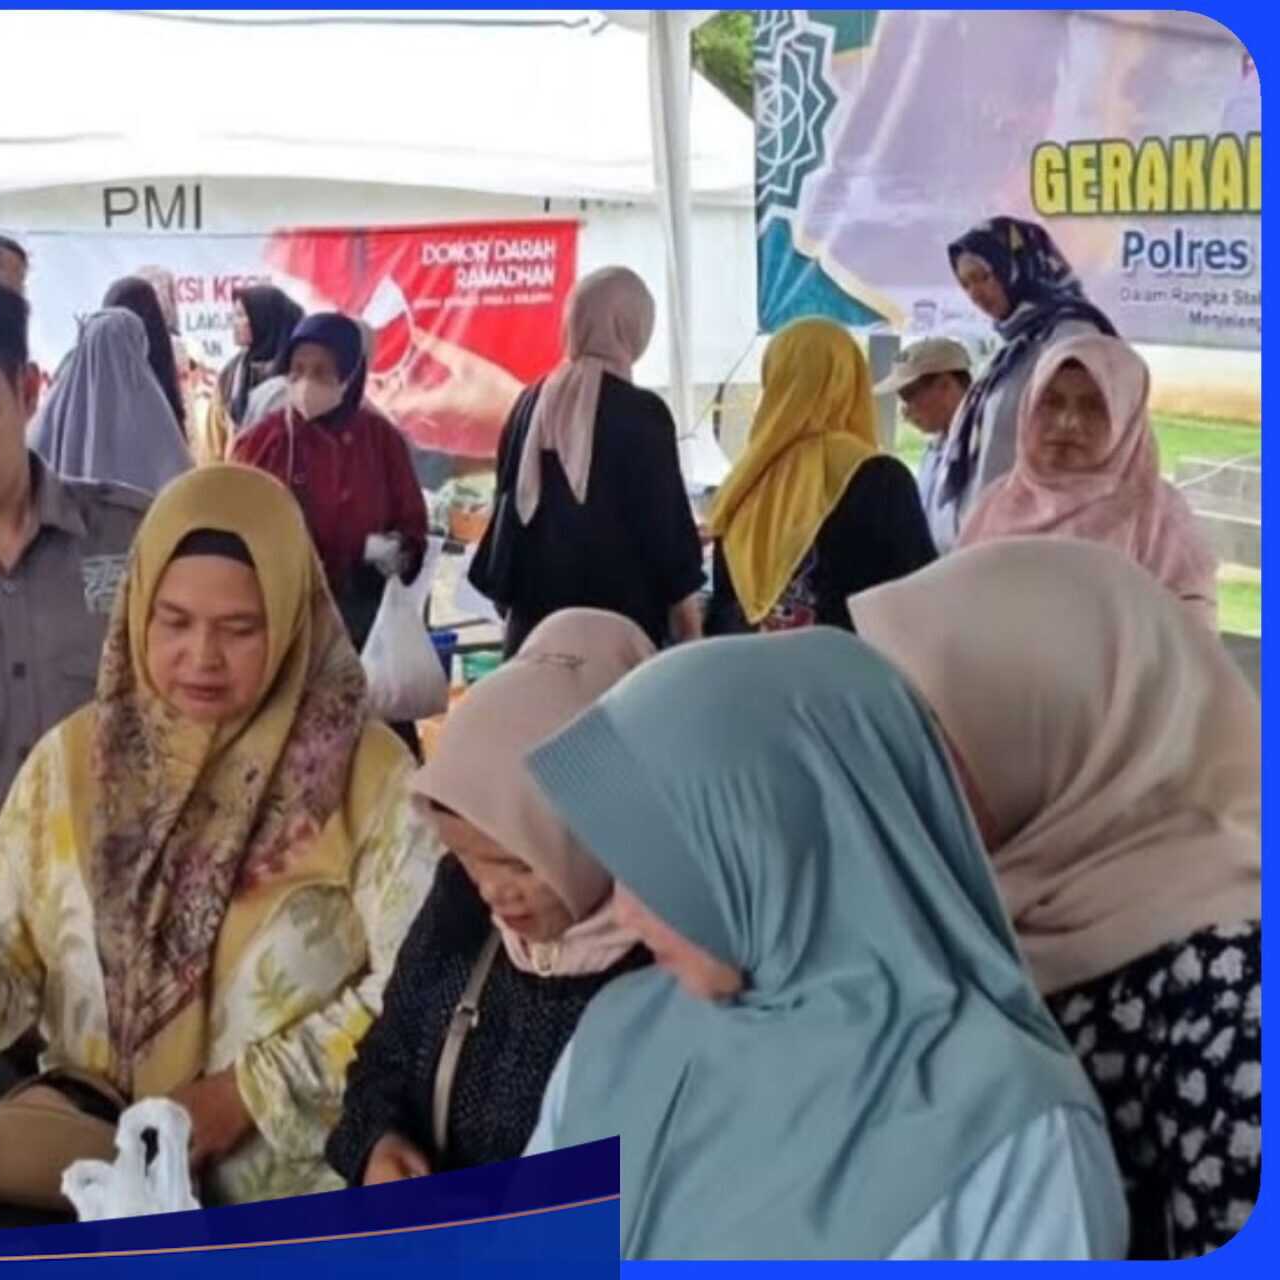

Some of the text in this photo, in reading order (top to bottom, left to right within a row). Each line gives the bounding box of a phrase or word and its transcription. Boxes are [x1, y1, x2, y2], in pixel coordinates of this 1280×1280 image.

[103, 184, 202, 230] PMI
[422, 240, 556, 265] DONOR DARAH
[1122, 229, 1248, 270] Polres
[456, 266, 555, 289] RAMADHAN
